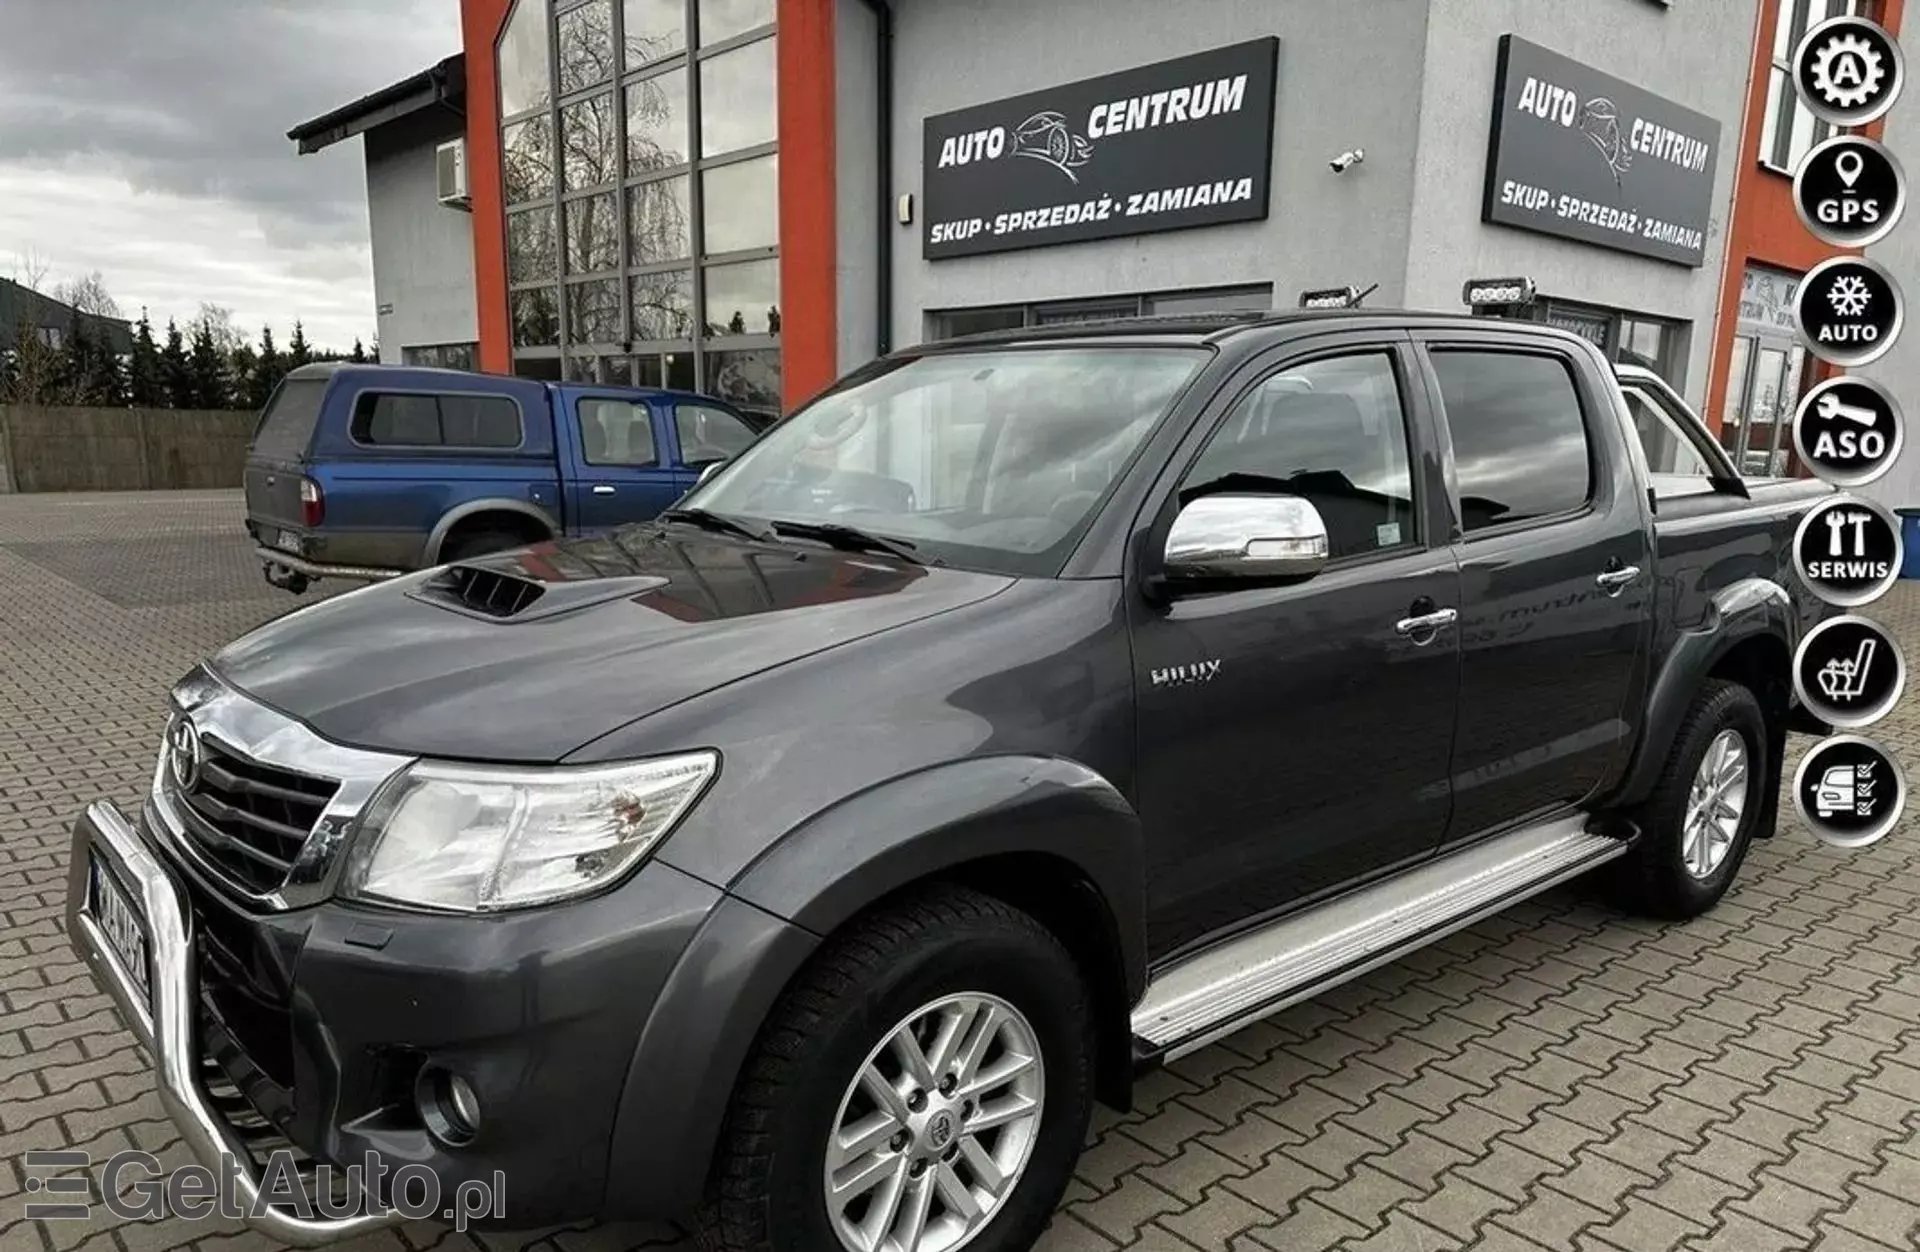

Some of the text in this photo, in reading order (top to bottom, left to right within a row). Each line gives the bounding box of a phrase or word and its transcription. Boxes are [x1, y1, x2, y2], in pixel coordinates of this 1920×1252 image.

[938, 74, 1248, 168] AUTO CENTRUM
[1518, 77, 1709, 173] AUTO CENTRUM
[930, 177, 1252, 243] SKUP SPRZEDAŻ ZAMIANA
[1501, 180, 1702, 250] SKUP SPRZEDAŻ ZAMIANA
